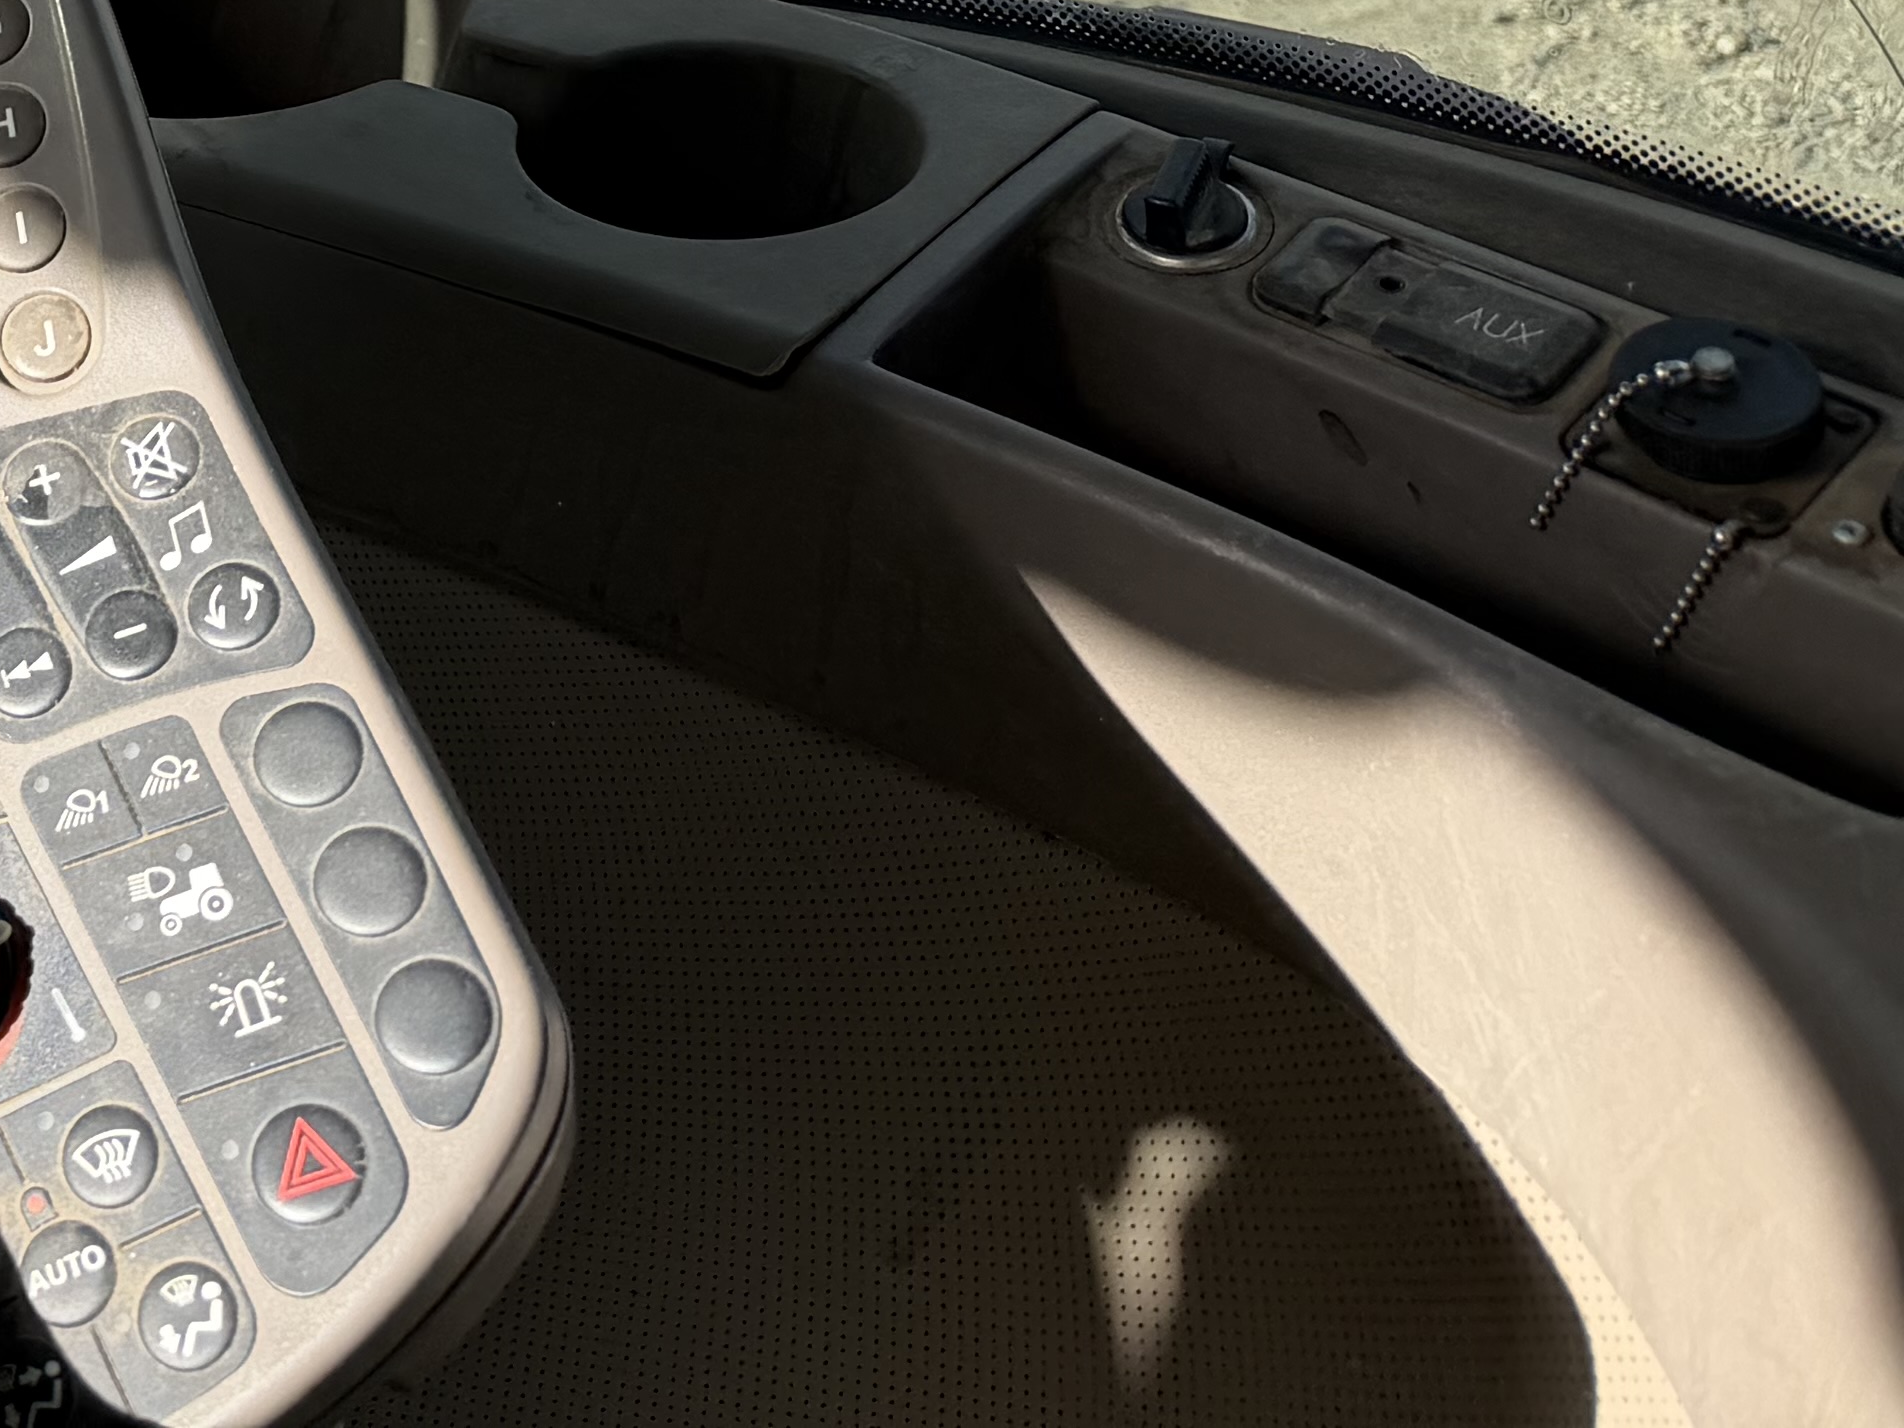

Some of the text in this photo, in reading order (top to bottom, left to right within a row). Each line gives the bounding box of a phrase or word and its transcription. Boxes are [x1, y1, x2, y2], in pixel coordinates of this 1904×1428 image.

[33, 319, 57, 358] J
[1453, 306, 1546, 344] AUX
[28, 1244, 107, 1298] AUTO
